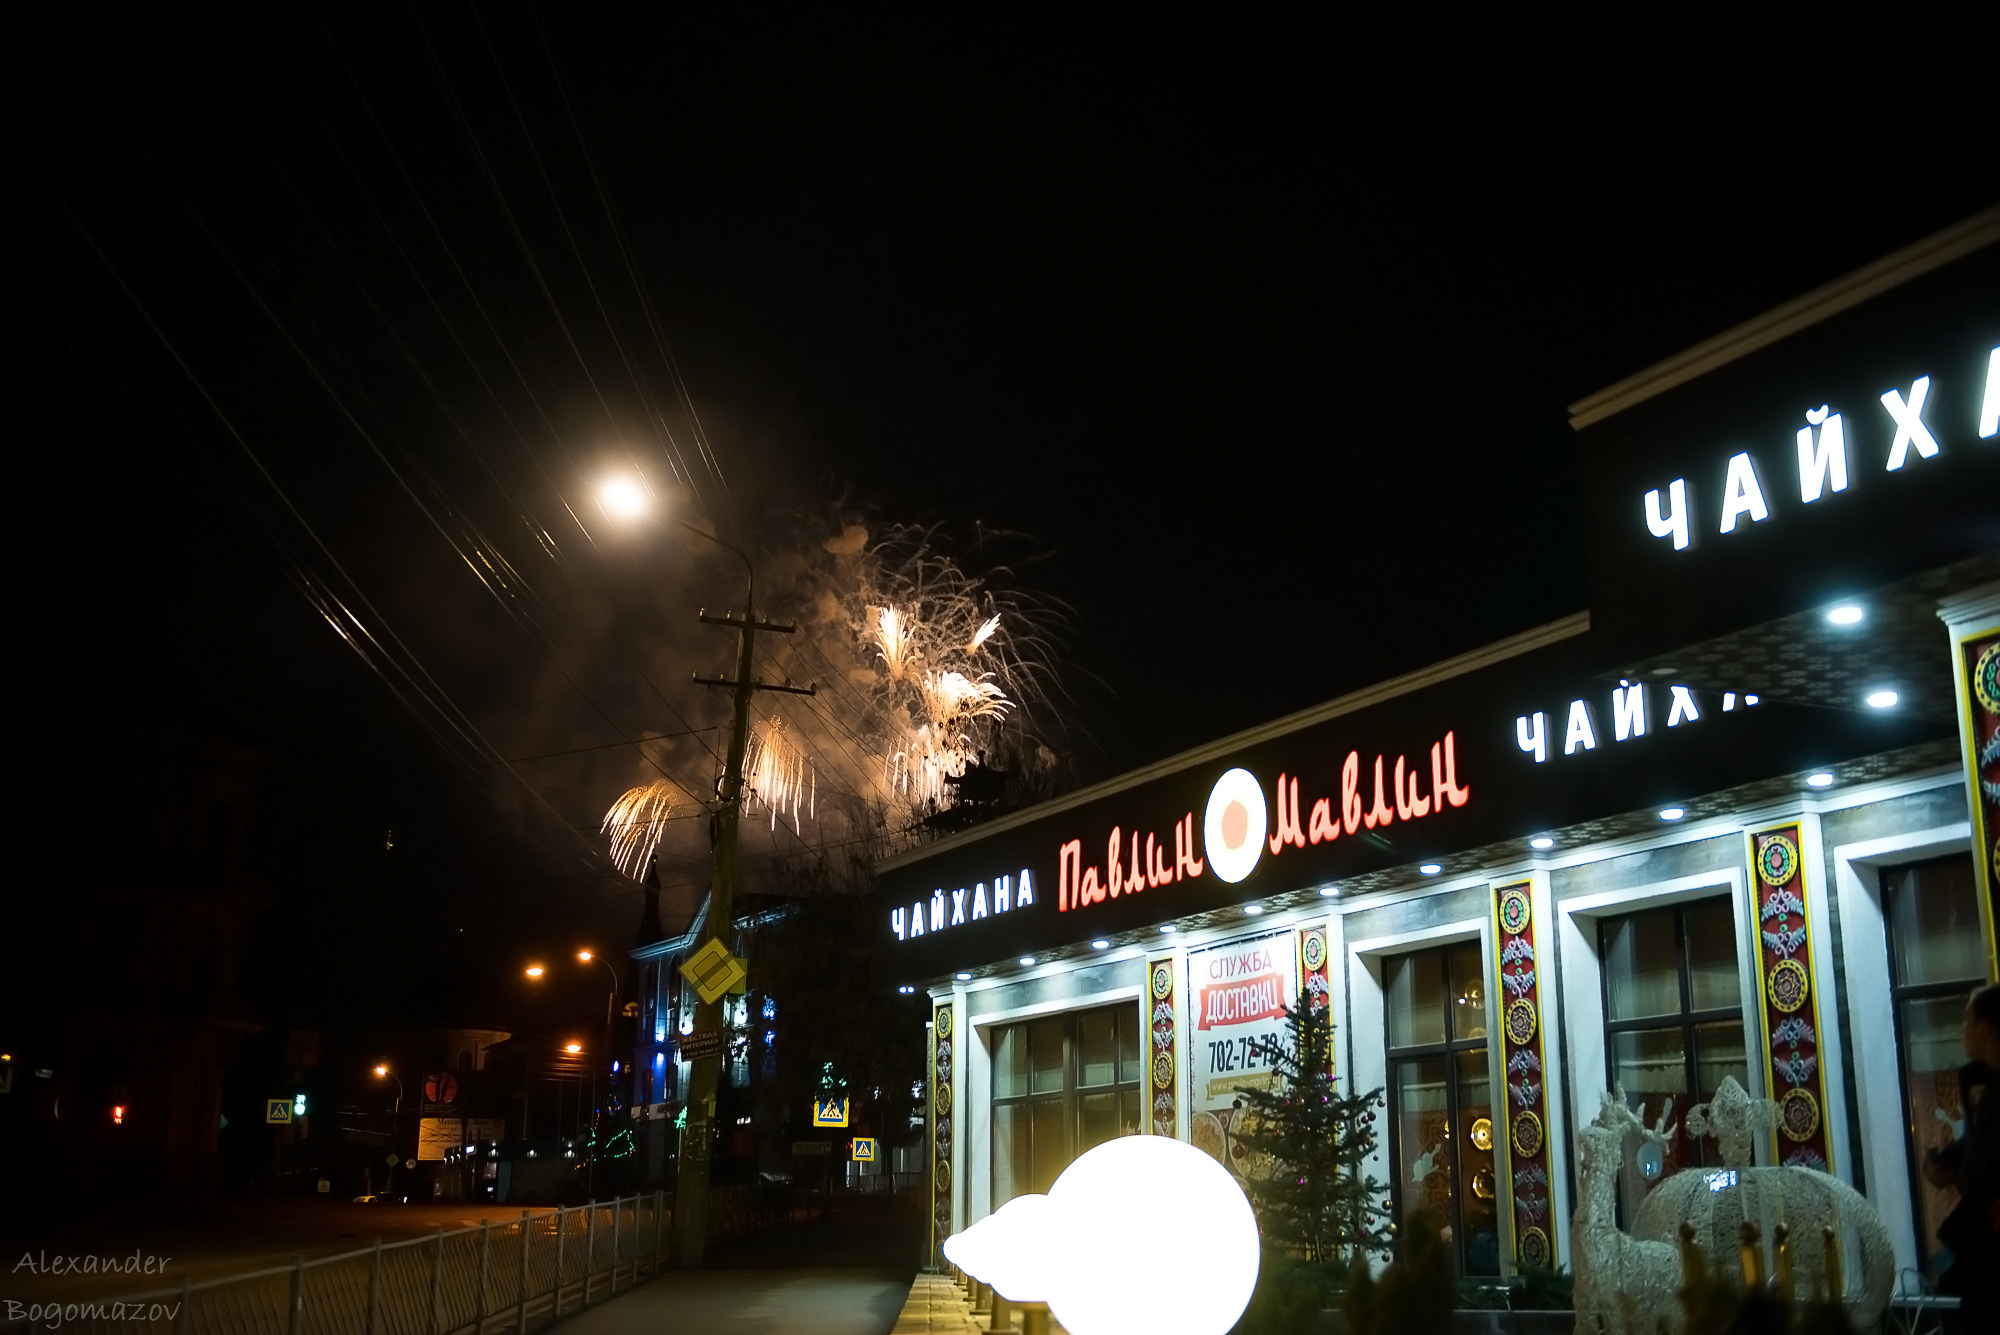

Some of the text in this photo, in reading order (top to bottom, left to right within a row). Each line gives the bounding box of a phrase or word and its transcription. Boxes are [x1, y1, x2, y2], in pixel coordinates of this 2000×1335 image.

[1516, 679, 1760, 763] ЧАЙХ
[1058, 730, 1470, 912] Павлин Мавлин
[891, 868, 1034, 941] ЧАЙХАНА
[1205, 977, 1279, 1023] ДОСТАВКИ
[1209, 948, 1273, 980] СЛУЖБА
